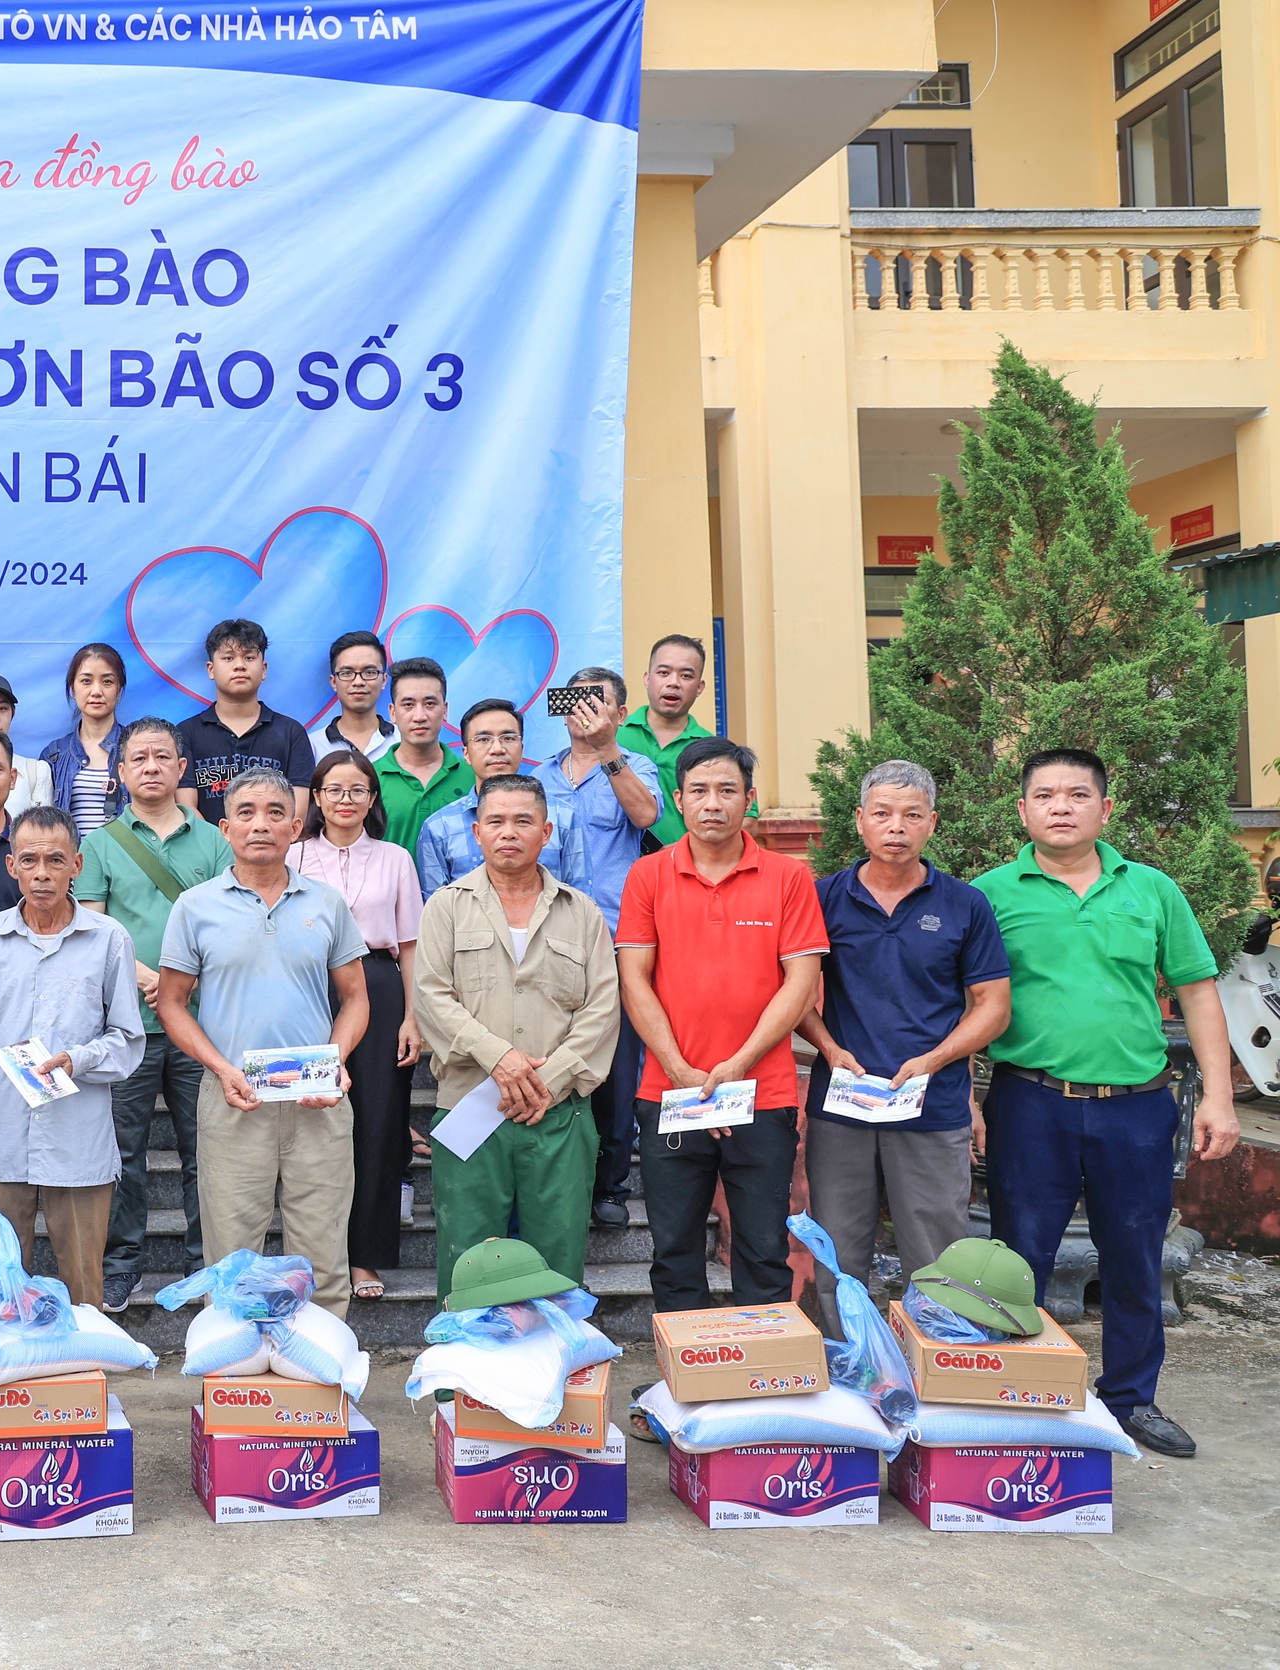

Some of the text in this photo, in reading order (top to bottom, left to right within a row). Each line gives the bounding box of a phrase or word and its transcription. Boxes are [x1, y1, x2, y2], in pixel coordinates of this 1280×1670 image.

[45, 14, 87, 41] VN
[94, 14, 117, 41] &
[125, 7, 192, 41] CÁC
[200, 7, 266, 42] NHÀ
[275, 5, 343, 41] HẢO
[350, 9, 418, 41] TÂM
[33, 132, 158, 206] đồng
[170, 134, 260, 191] bào
[83, 228, 251, 307] BÀO
[108, 332, 276, 409] BÃO
[295, 323, 403, 411] SỐ
[423, 352, 465, 412] 3
[44, 434, 148, 504] BÁI
[195, 753, 282, 772] HILFIGER
[22, 1440, 72, 1451] MINERAL
[76, 1438, 114, 1449] WATER
[239, 1438, 357, 1451] NATURAL MINERAL WATER
[734, 1446, 856, 1456] NATURAL MINERAL WATER
[955, 1449, 1085, 1459] NATURAL MINERAL WATER
[474, 1509, 608, 1519] NƯỚC KHOÁNG THIÊN NHIÊN
[936, 1513, 985, 1523] 24 Bottles 350 ML
[1075, 1513, 1106, 1523] KHOÁNG
[95, 1517, 129, 1527] KHOÁNG
